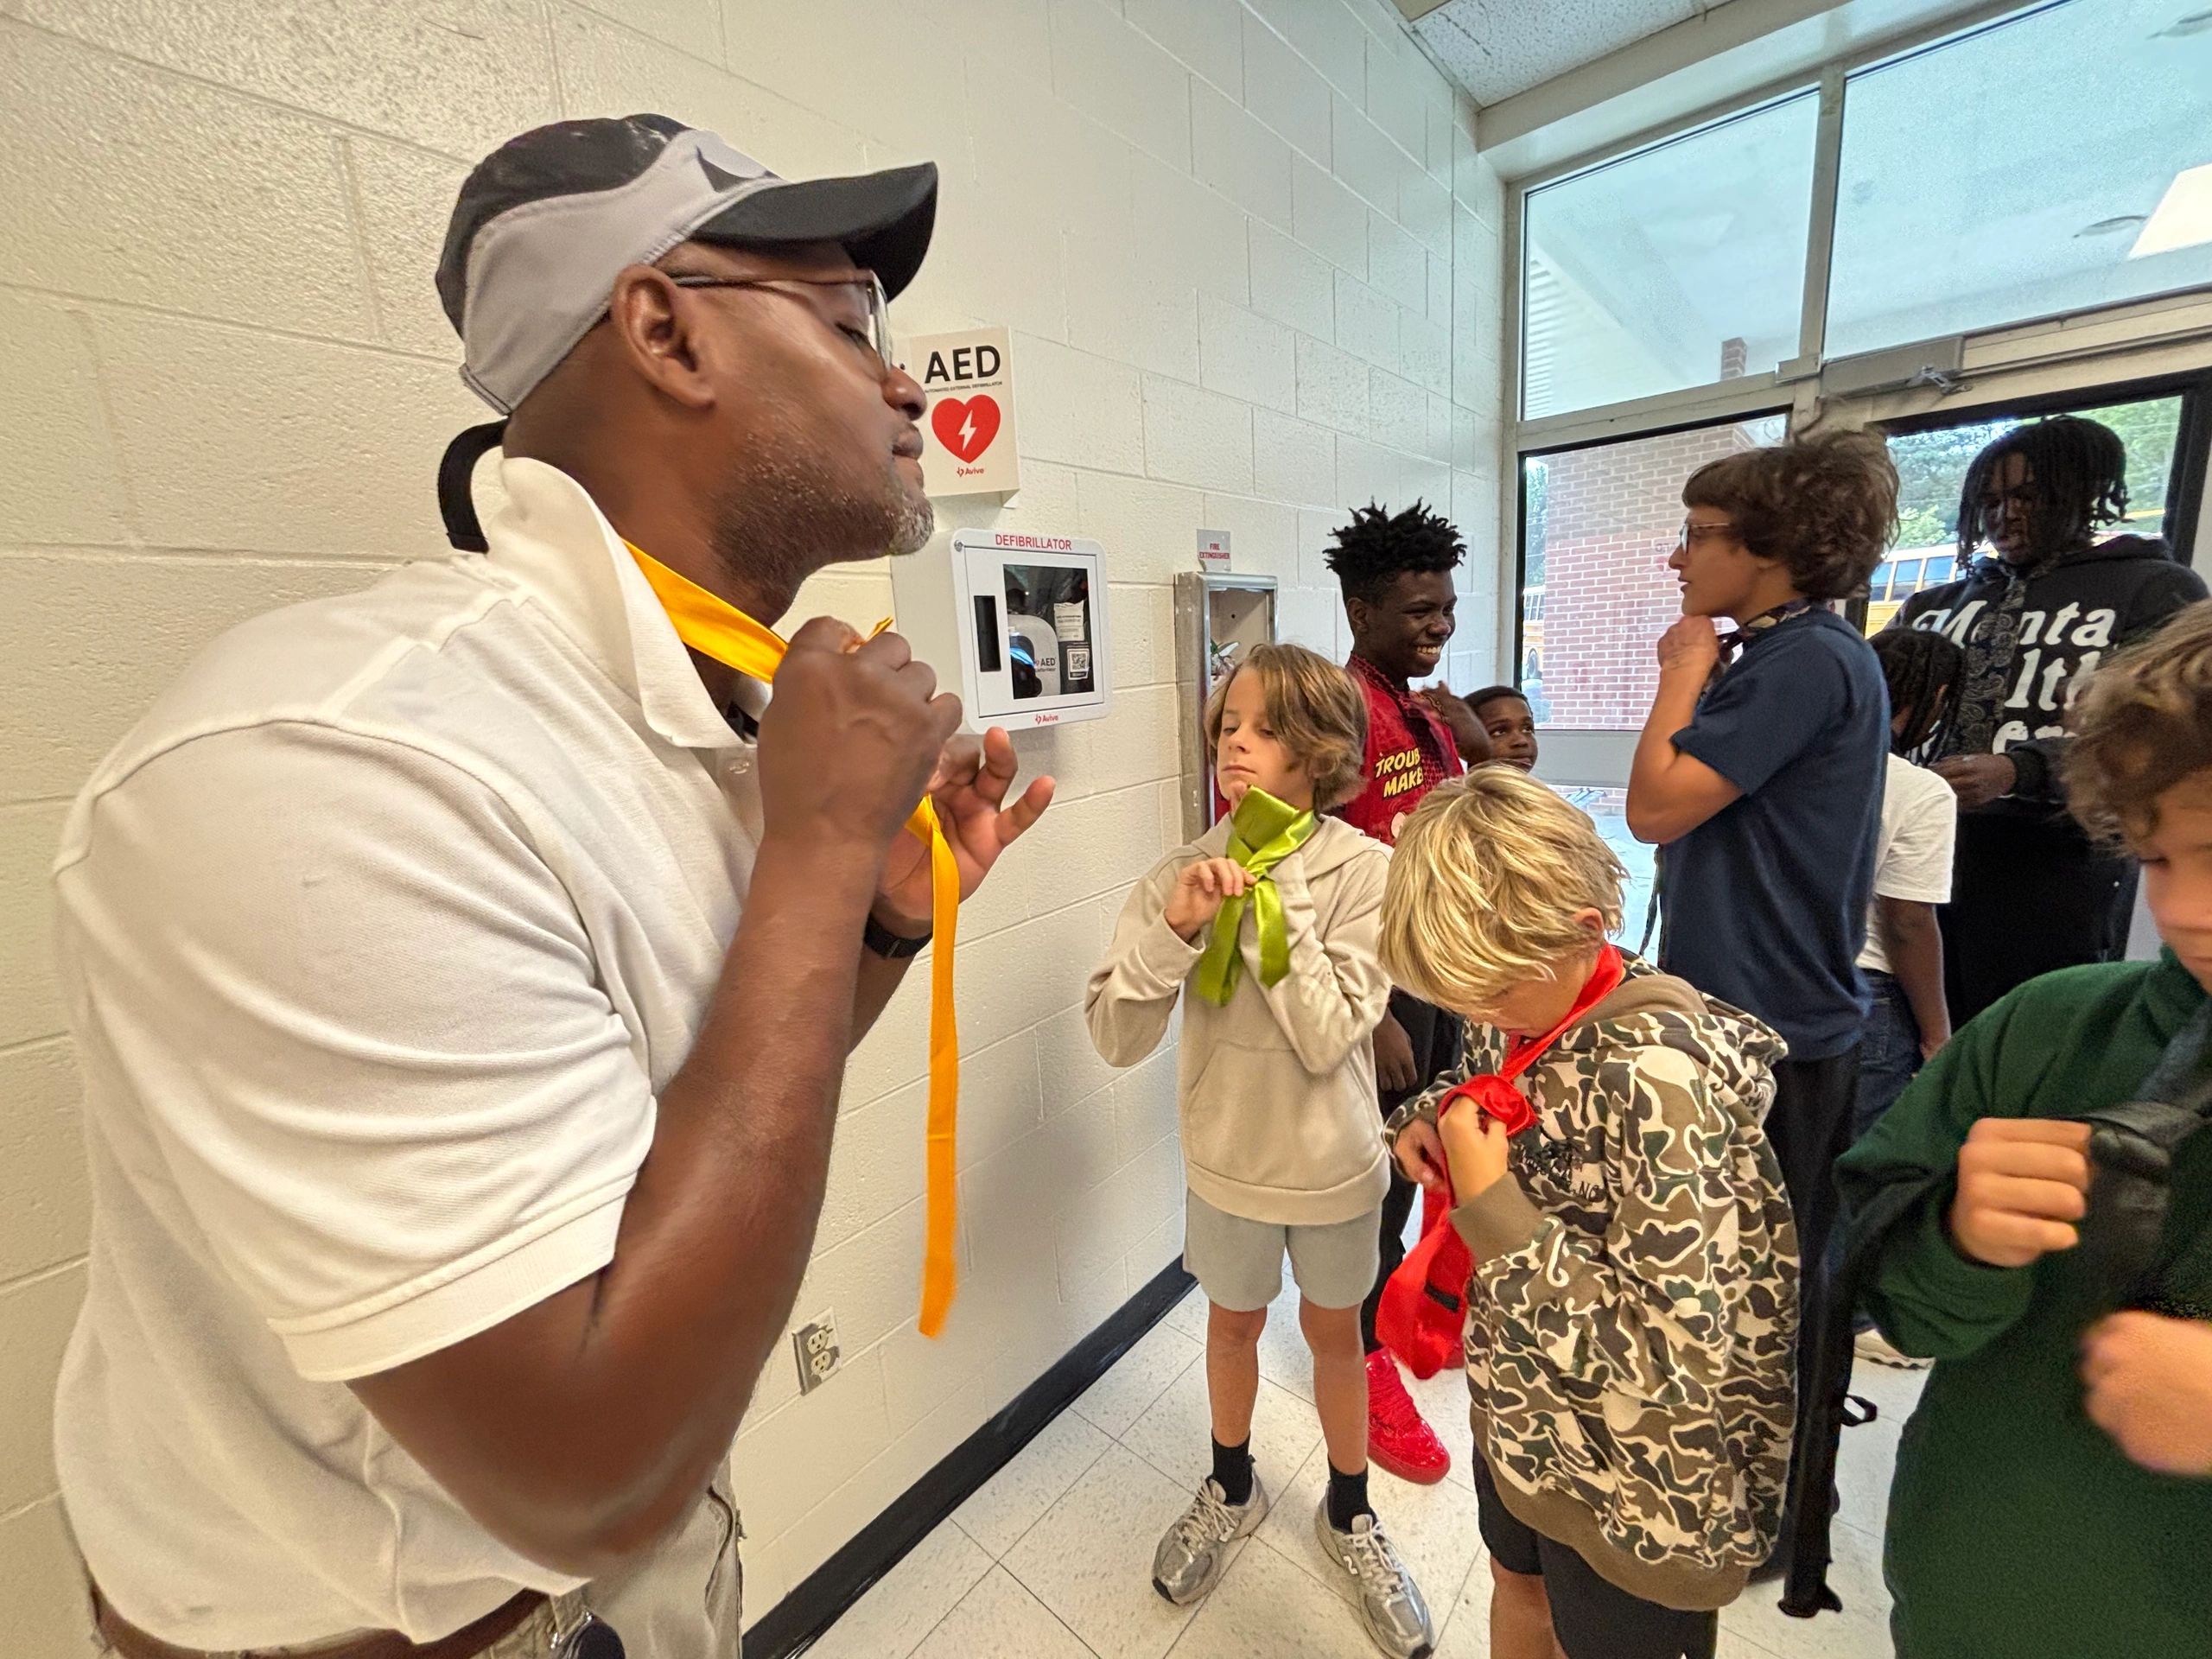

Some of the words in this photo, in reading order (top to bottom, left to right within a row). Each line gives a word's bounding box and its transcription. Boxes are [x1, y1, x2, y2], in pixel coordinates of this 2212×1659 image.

[925, 345, 1001, 384] AED
[965, 467, 984, 475] Avive
[995, 534, 1071, 550] DEFIBRILLATOR
[1198, 551, 1230, 560] EXTINGUISHER
[1040, 657, 1056, 667] AED
